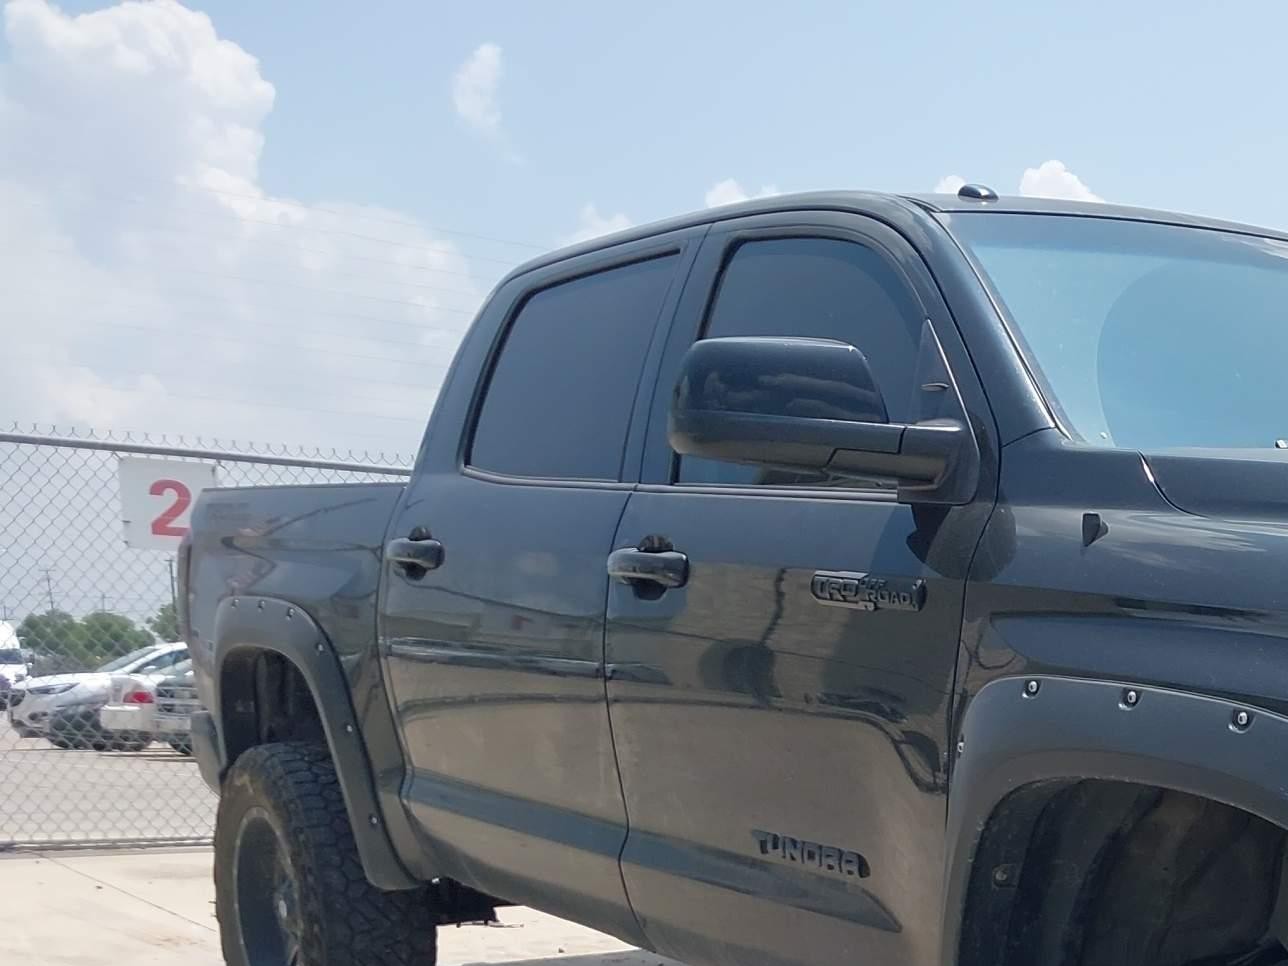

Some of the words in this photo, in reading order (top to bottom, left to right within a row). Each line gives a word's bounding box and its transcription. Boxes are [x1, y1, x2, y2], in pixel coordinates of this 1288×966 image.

[149, 479, 192, 537] 2
[814, 576, 859, 602] TRD
[860, 577, 888, 590] OFF
[865, 589, 911, 606] ROAD
[752, 829, 871, 878] TUNDRA
